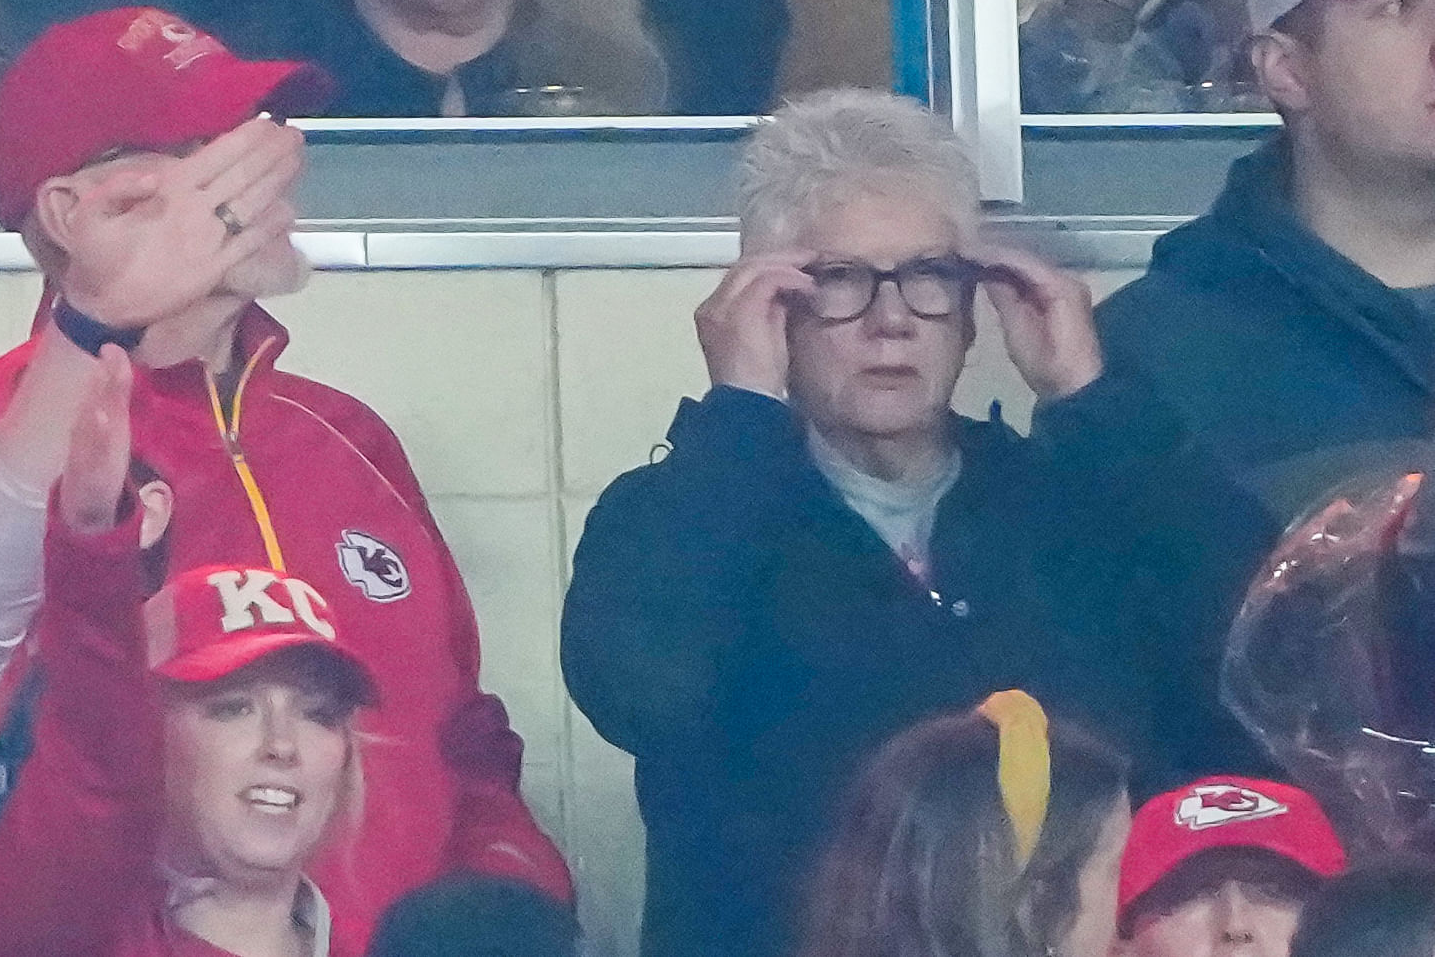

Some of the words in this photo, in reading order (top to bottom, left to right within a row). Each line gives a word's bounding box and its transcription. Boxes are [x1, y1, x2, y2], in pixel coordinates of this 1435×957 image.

[357, 546, 403, 588] KC
[206, 569, 336, 642] KC
[1200, 791, 1260, 812] KC
